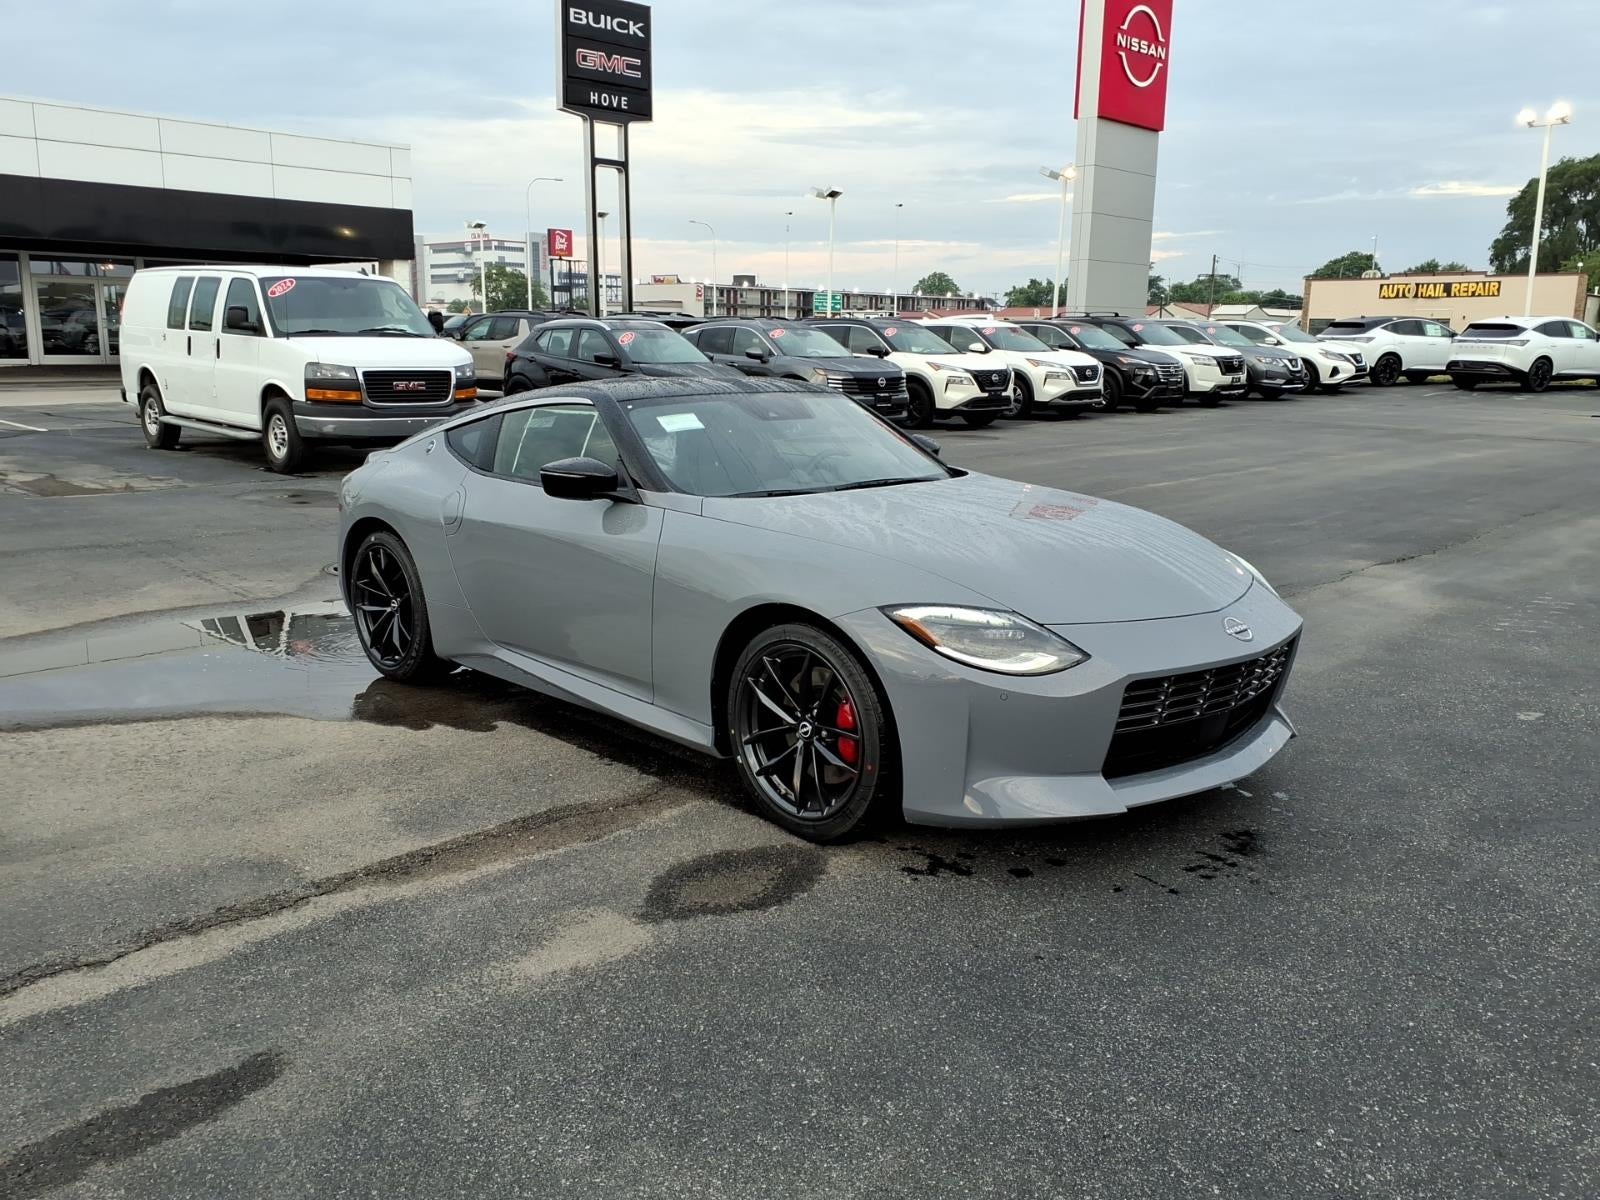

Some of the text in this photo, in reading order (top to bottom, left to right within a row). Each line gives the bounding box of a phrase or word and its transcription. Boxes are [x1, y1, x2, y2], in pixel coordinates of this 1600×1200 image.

[570, 7, 645, 37] BUICK
[1117, 32, 1166, 60] NISSAN
[576, 48, 641, 78] GMC
[590, 91, 629, 110] HOVE
[271, 280, 292, 296] 2024
[1381, 282, 1499, 298] AUTO HAIL REPAIR
[392, 381, 426, 391] GMC
